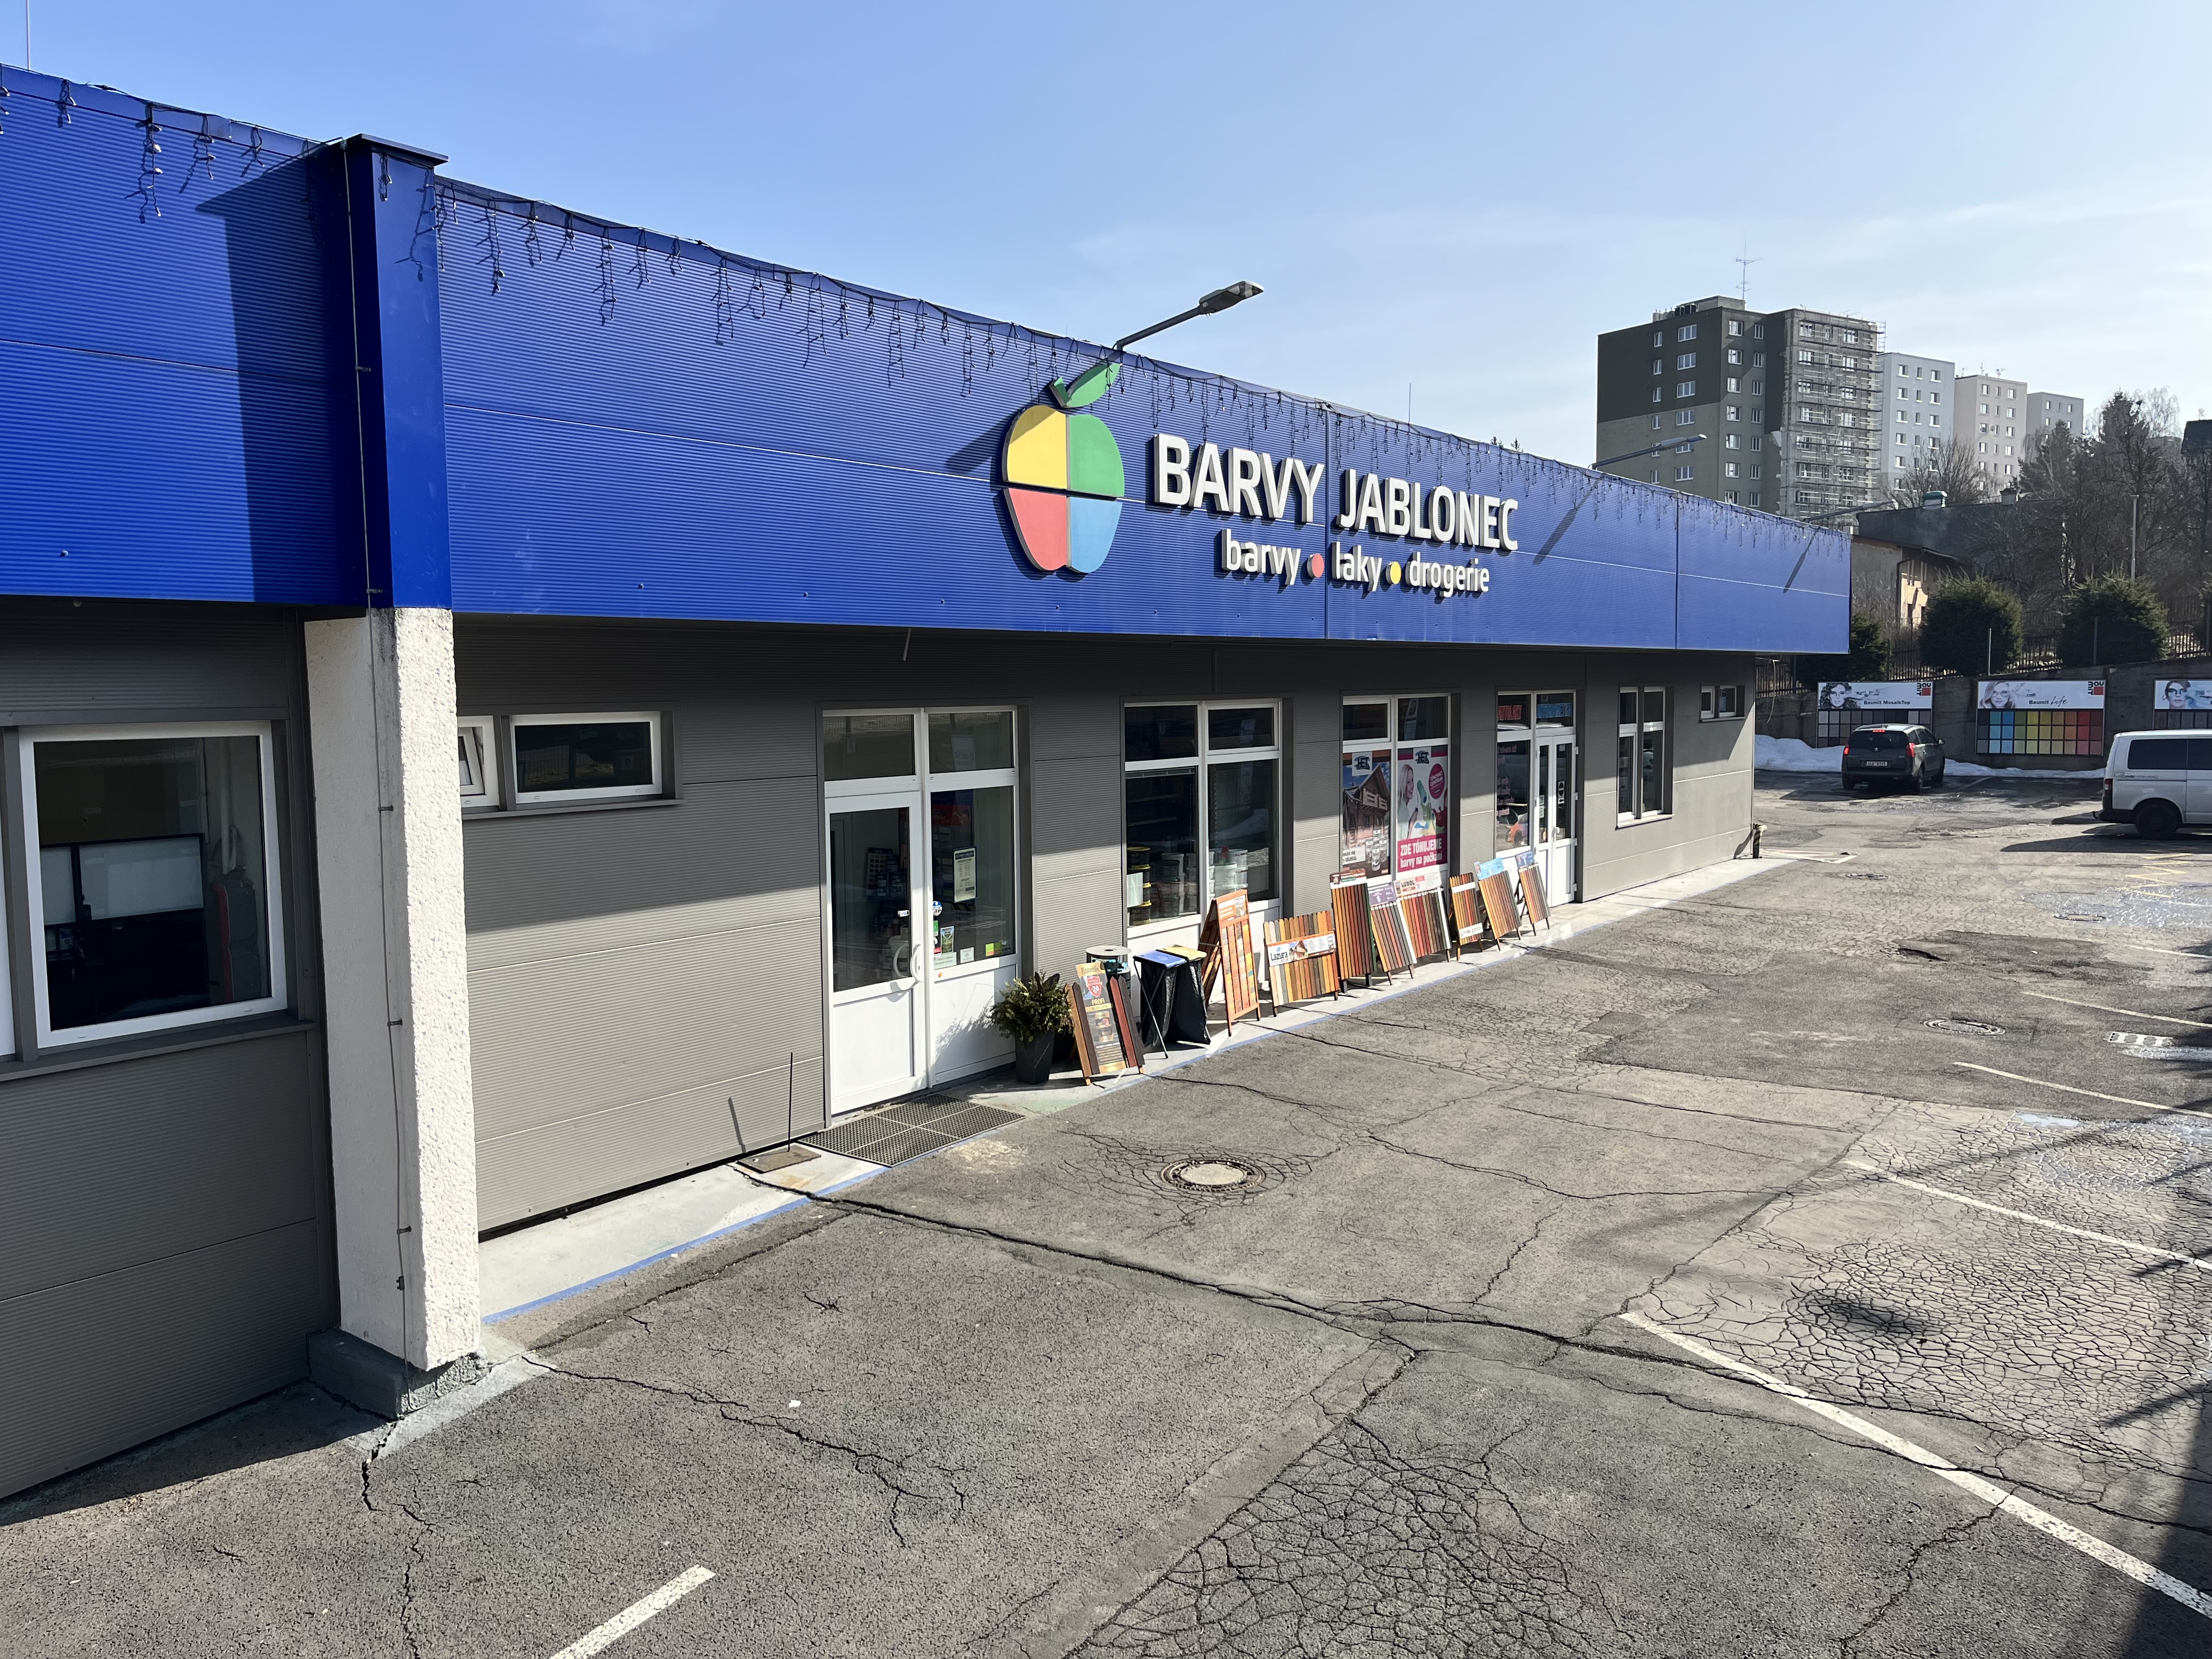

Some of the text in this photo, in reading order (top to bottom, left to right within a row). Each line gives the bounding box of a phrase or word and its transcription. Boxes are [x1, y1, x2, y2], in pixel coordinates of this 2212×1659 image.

[1155, 433, 1518, 551] BARVY JABLONEC
[1222, 528, 1489, 598] barvy laky drogerie
[2050, 695, 2068, 708] Life
[1400, 839, 1442, 856] ZDE TÓNUJEME
[1400, 850, 1442, 868] barvy na počkání
[1271, 951, 1288, 961] Lazura
[1081, 966, 1099, 974] Estetik
[1091, 997, 1105, 1006] PROFI
